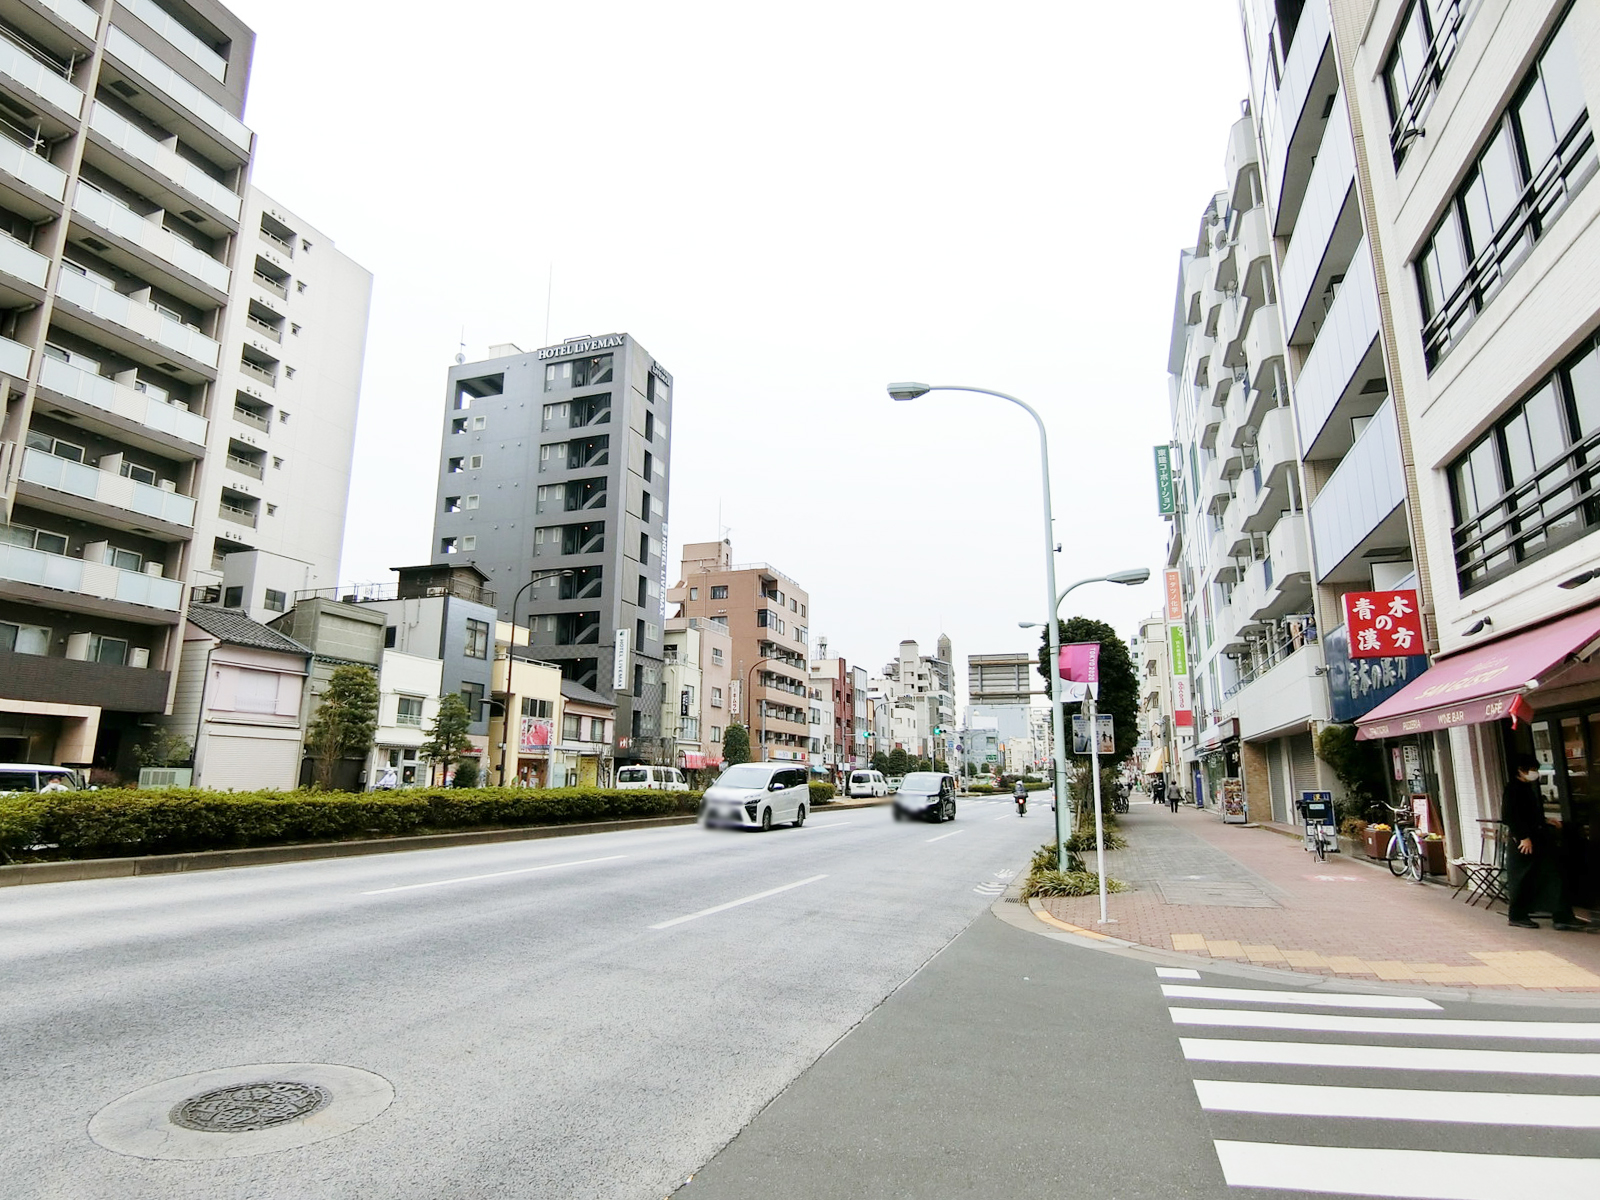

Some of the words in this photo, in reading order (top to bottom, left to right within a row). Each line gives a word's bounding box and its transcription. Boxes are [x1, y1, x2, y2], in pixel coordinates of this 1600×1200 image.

[538, 345, 572, 360] HOTEL
[1437, 712, 1452, 725] WINE
[1451, 711, 1464, 723] BAR
[1485, 700, 1503, 716] CAFÉ
